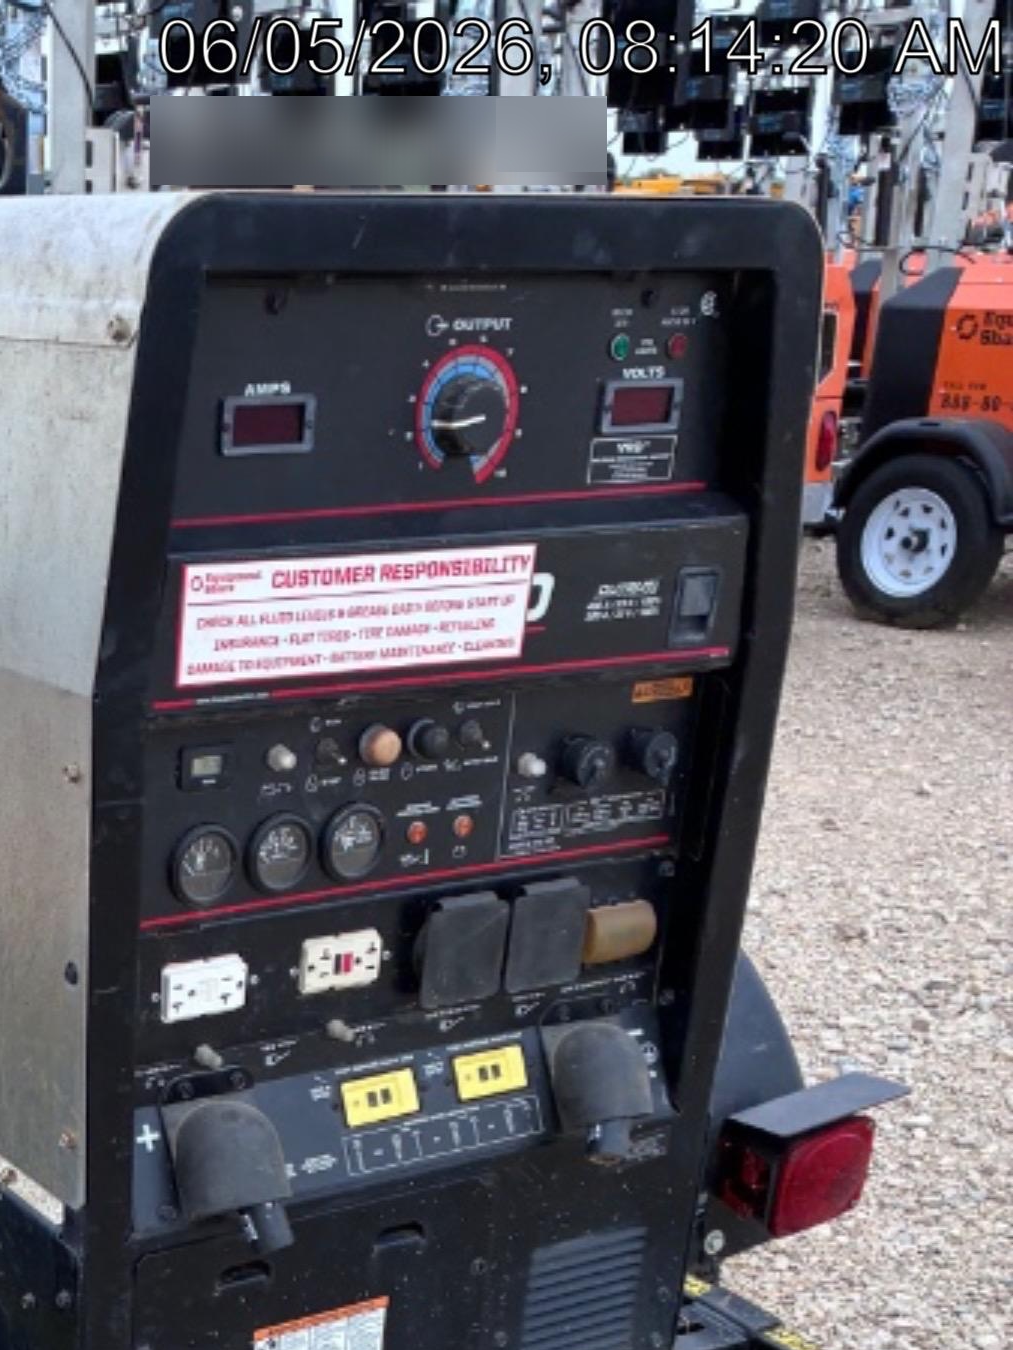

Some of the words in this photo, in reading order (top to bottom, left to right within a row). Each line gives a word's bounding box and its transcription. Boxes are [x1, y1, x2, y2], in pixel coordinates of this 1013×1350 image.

[452, 317, 513, 331] OUTPUT
[622, 365, 666, 380] VOLTS
[244, 381, 292, 397] AMPS
[271, 565, 376, 589] CUSTOMER
[379, 554, 531, 583] RESPONSIBILITY
[236, 614, 257, 627] ALL
